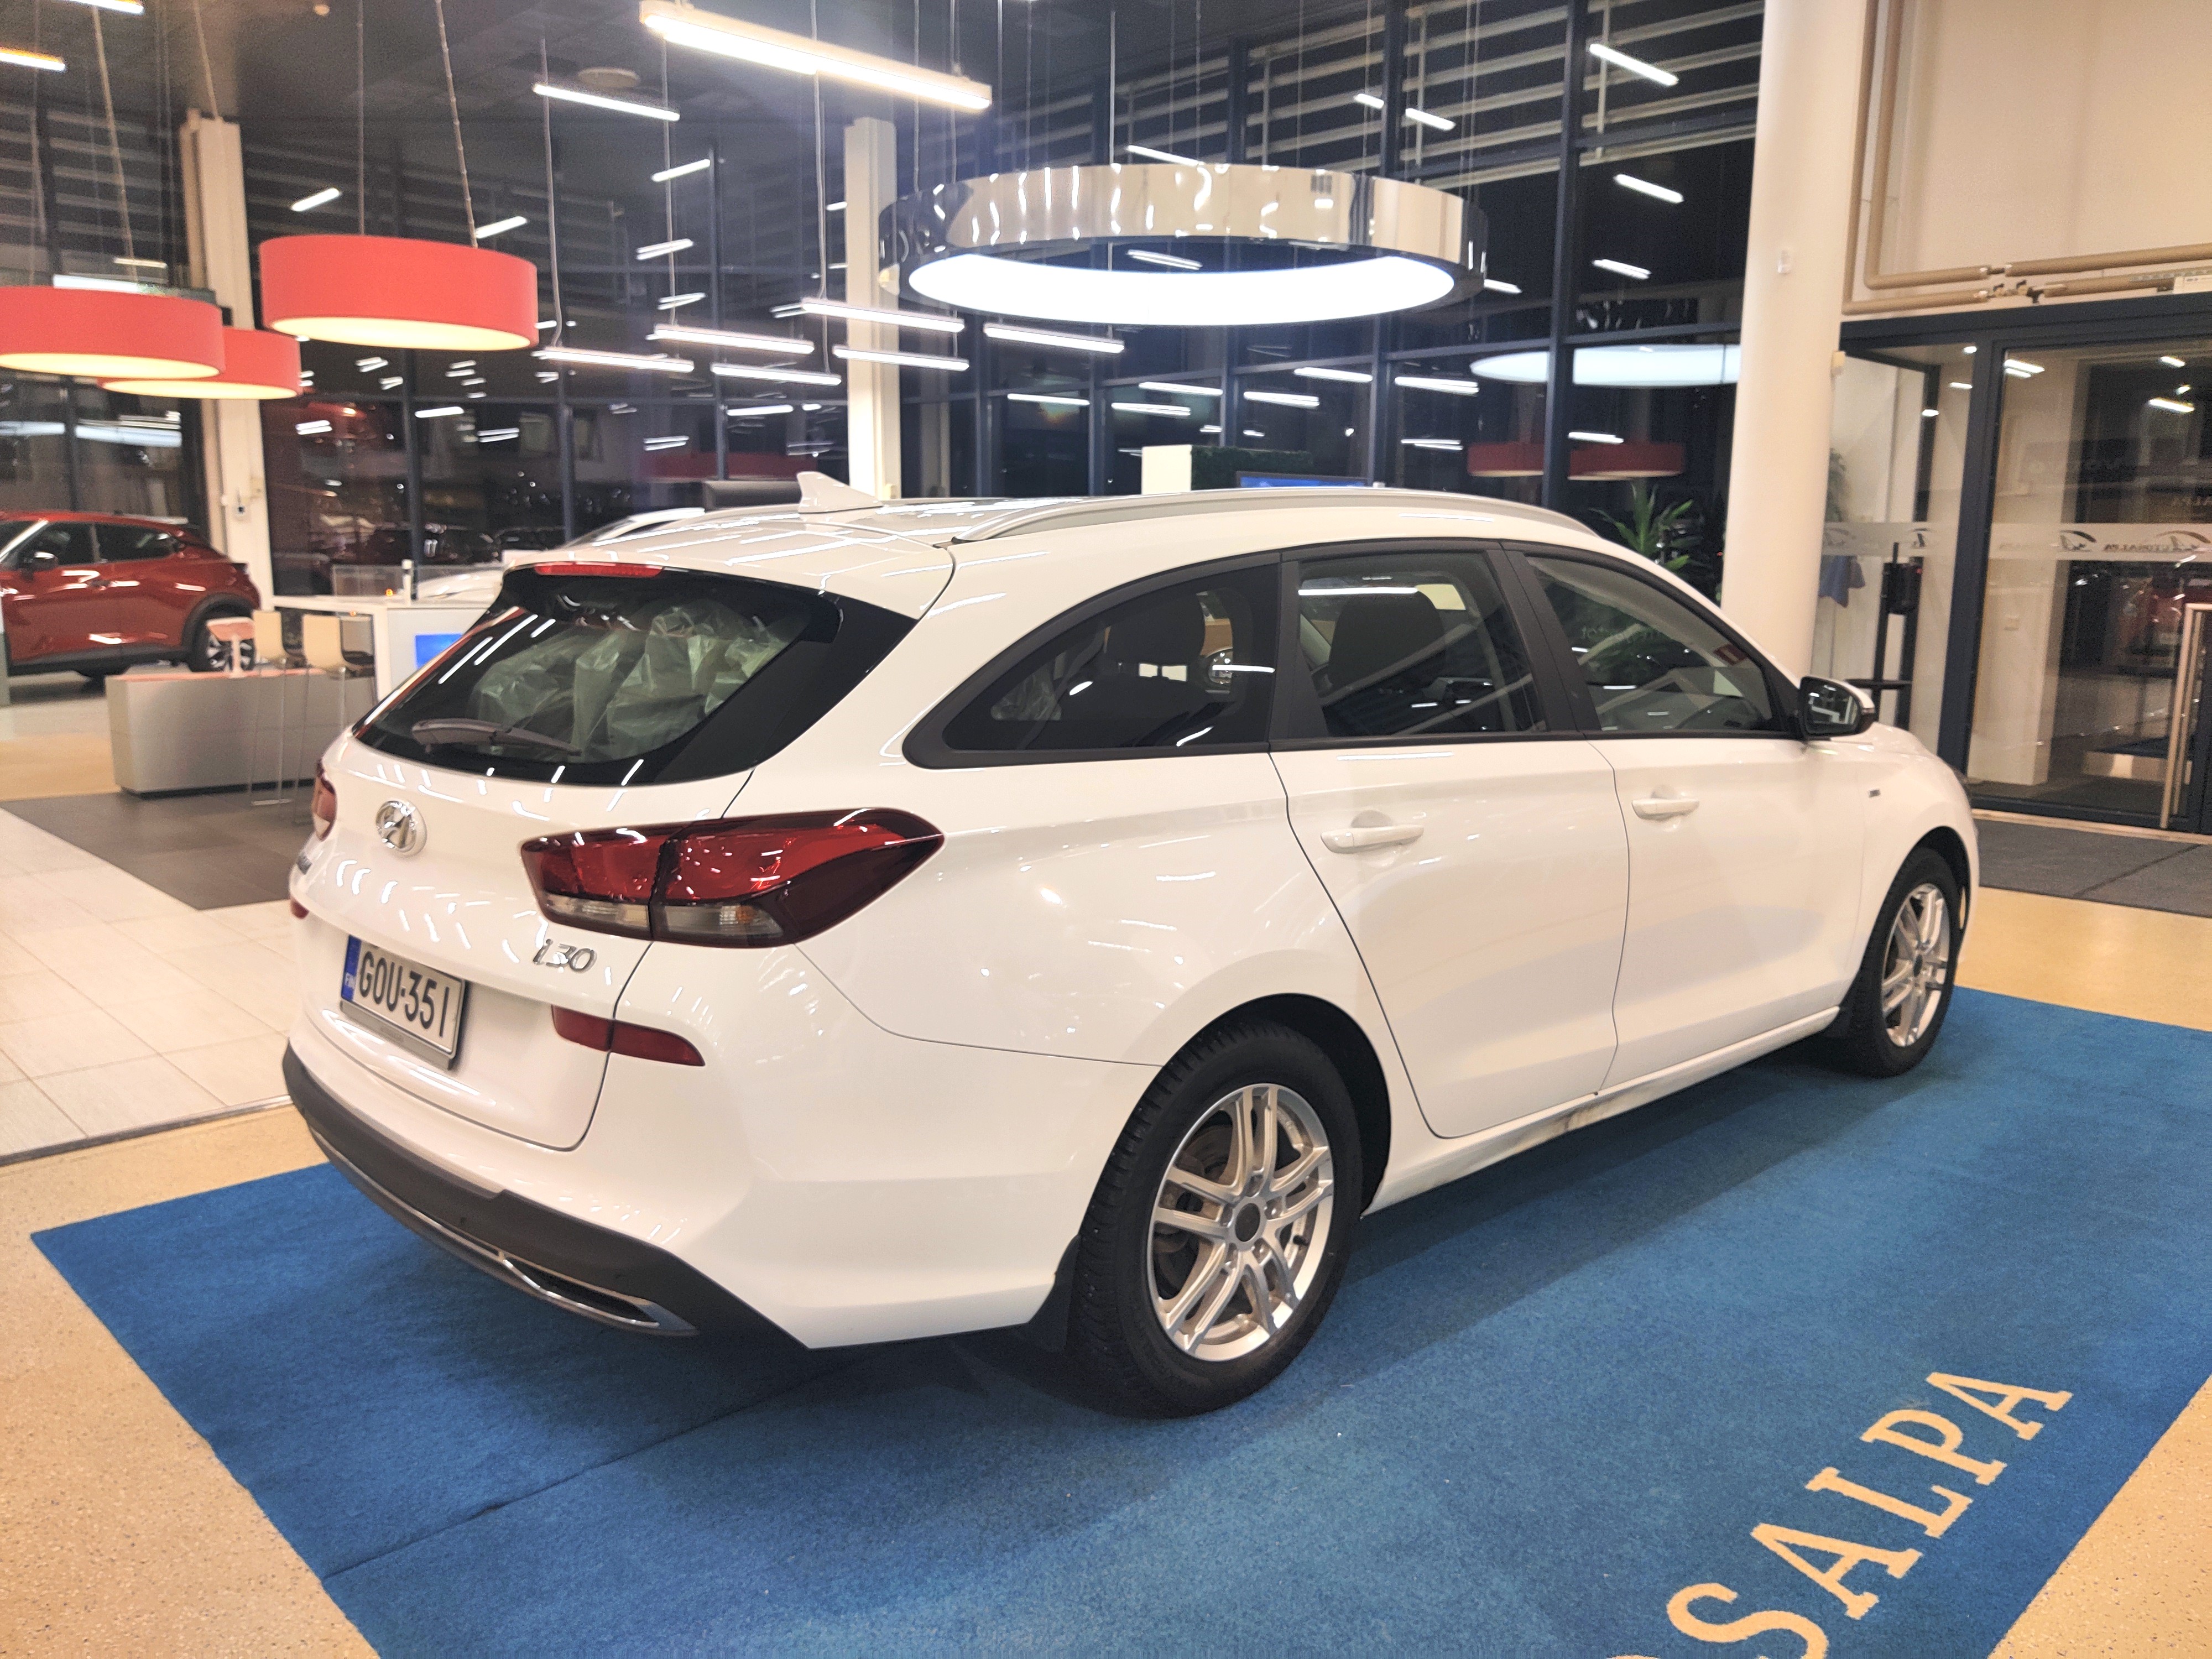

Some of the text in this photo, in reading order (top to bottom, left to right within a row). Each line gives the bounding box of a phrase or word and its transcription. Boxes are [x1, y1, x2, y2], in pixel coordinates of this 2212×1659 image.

[360, 951, 450, 1037] GOU-351
[533, 938, 598, 973] i30
[1606, 1371, 2073, 1659] SALPA
